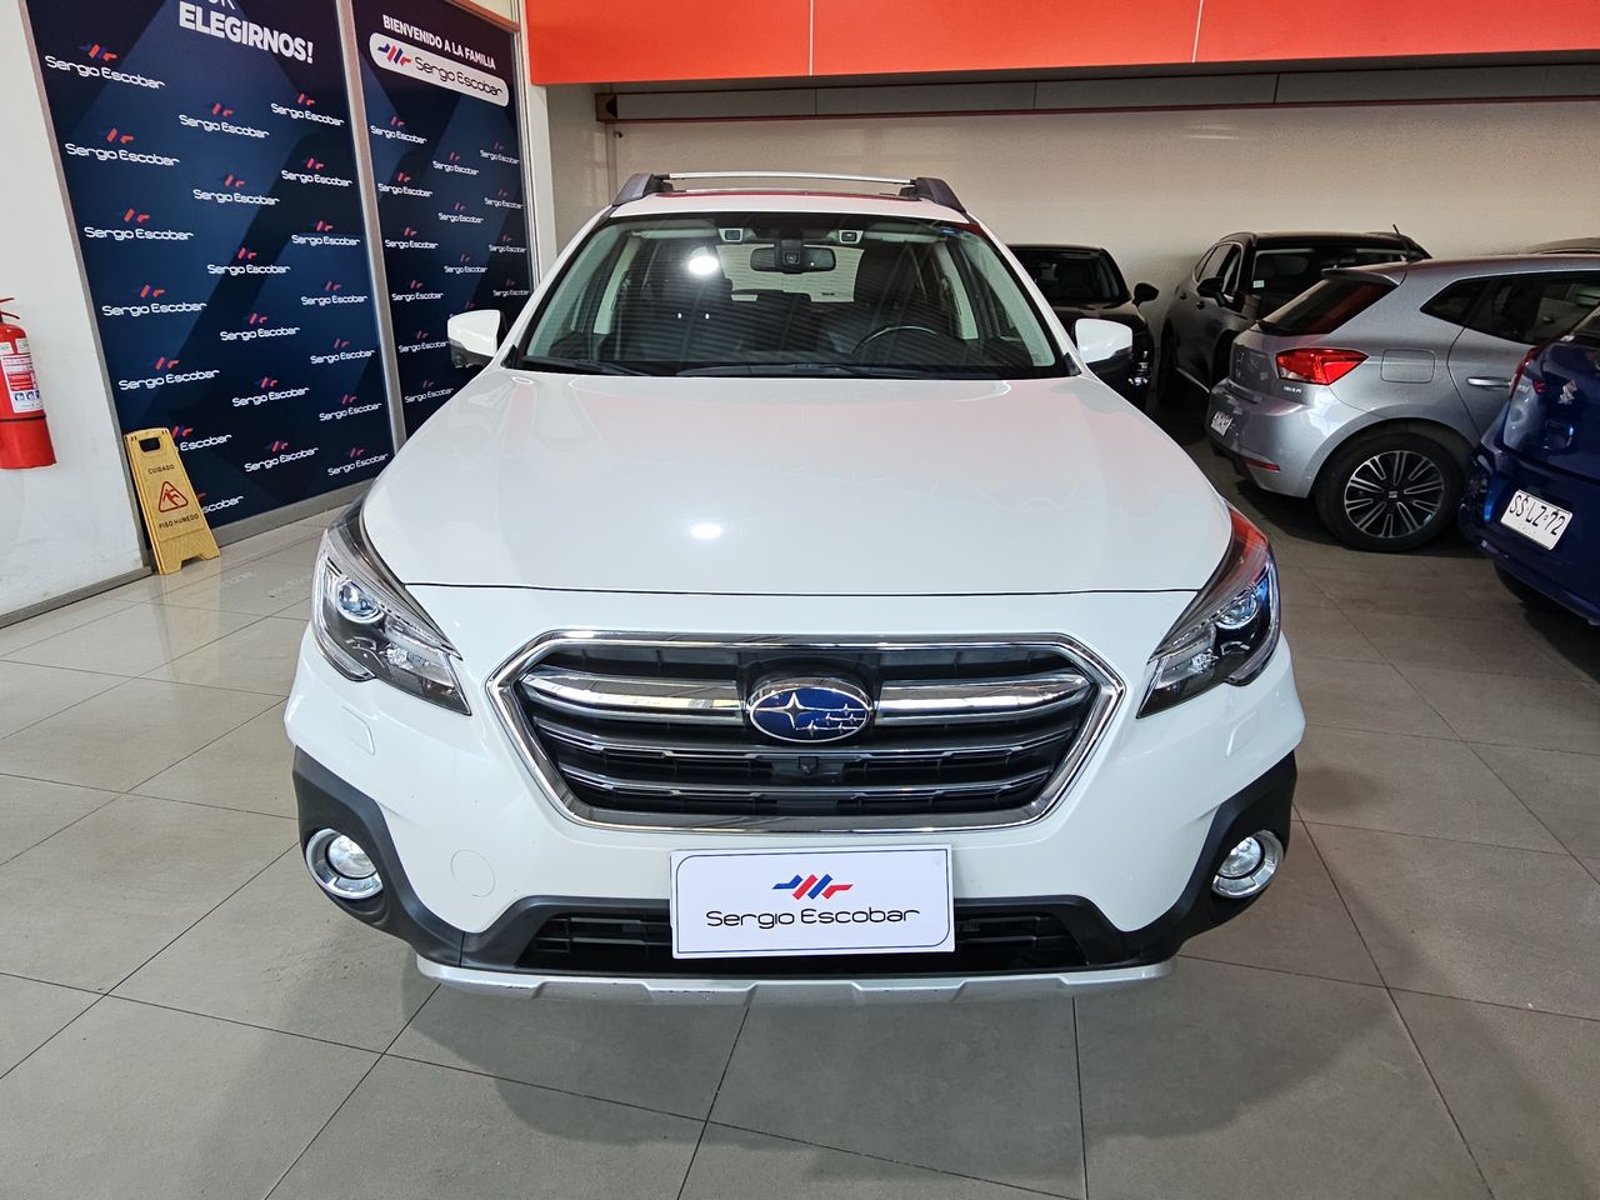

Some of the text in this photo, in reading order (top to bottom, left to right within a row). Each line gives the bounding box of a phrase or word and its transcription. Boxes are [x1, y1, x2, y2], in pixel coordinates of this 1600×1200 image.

[179, 1, 313, 64] ELEGIRNOS!
[382, 14, 496, 70] BIENVENIDO A LA FAMILIA
[100, 67, 165, 89] Escobar
[457, 72, 502, 96] Escobar
[304, 109, 345, 126] Escobar
[220, 121, 270, 138] Escobar
[117, 149, 180, 166] Escobar
[313, 174, 353, 187] Escobar
[233, 192, 280, 206] Escobar
[135, 228, 194, 240] Escobar
[323, 236, 360, 246] Escobar
[246, 264, 291, 274] Escobar
[331, 295, 368, 304] Escobar
[150, 302, 207, 313] Escobar
[257, 327, 300, 338] Escobar
[339, 350, 375, 360] Escobar
[164, 370, 220, 383] Escobar
[268, 387, 309, 400] Escobar
[347, 403, 382, 415] Escobar
[180, 434, 232, 451] Escobar
[279, 447, 319, 463] Escobar
[355, 454, 389, 468] Escobar
[148, 464, 175, 474] CUIDADO
[202, 496, 244, 513] scobar
[159, 520, 173, 529] PISO
[706, 907, 920, 929] Sergio Escobar
